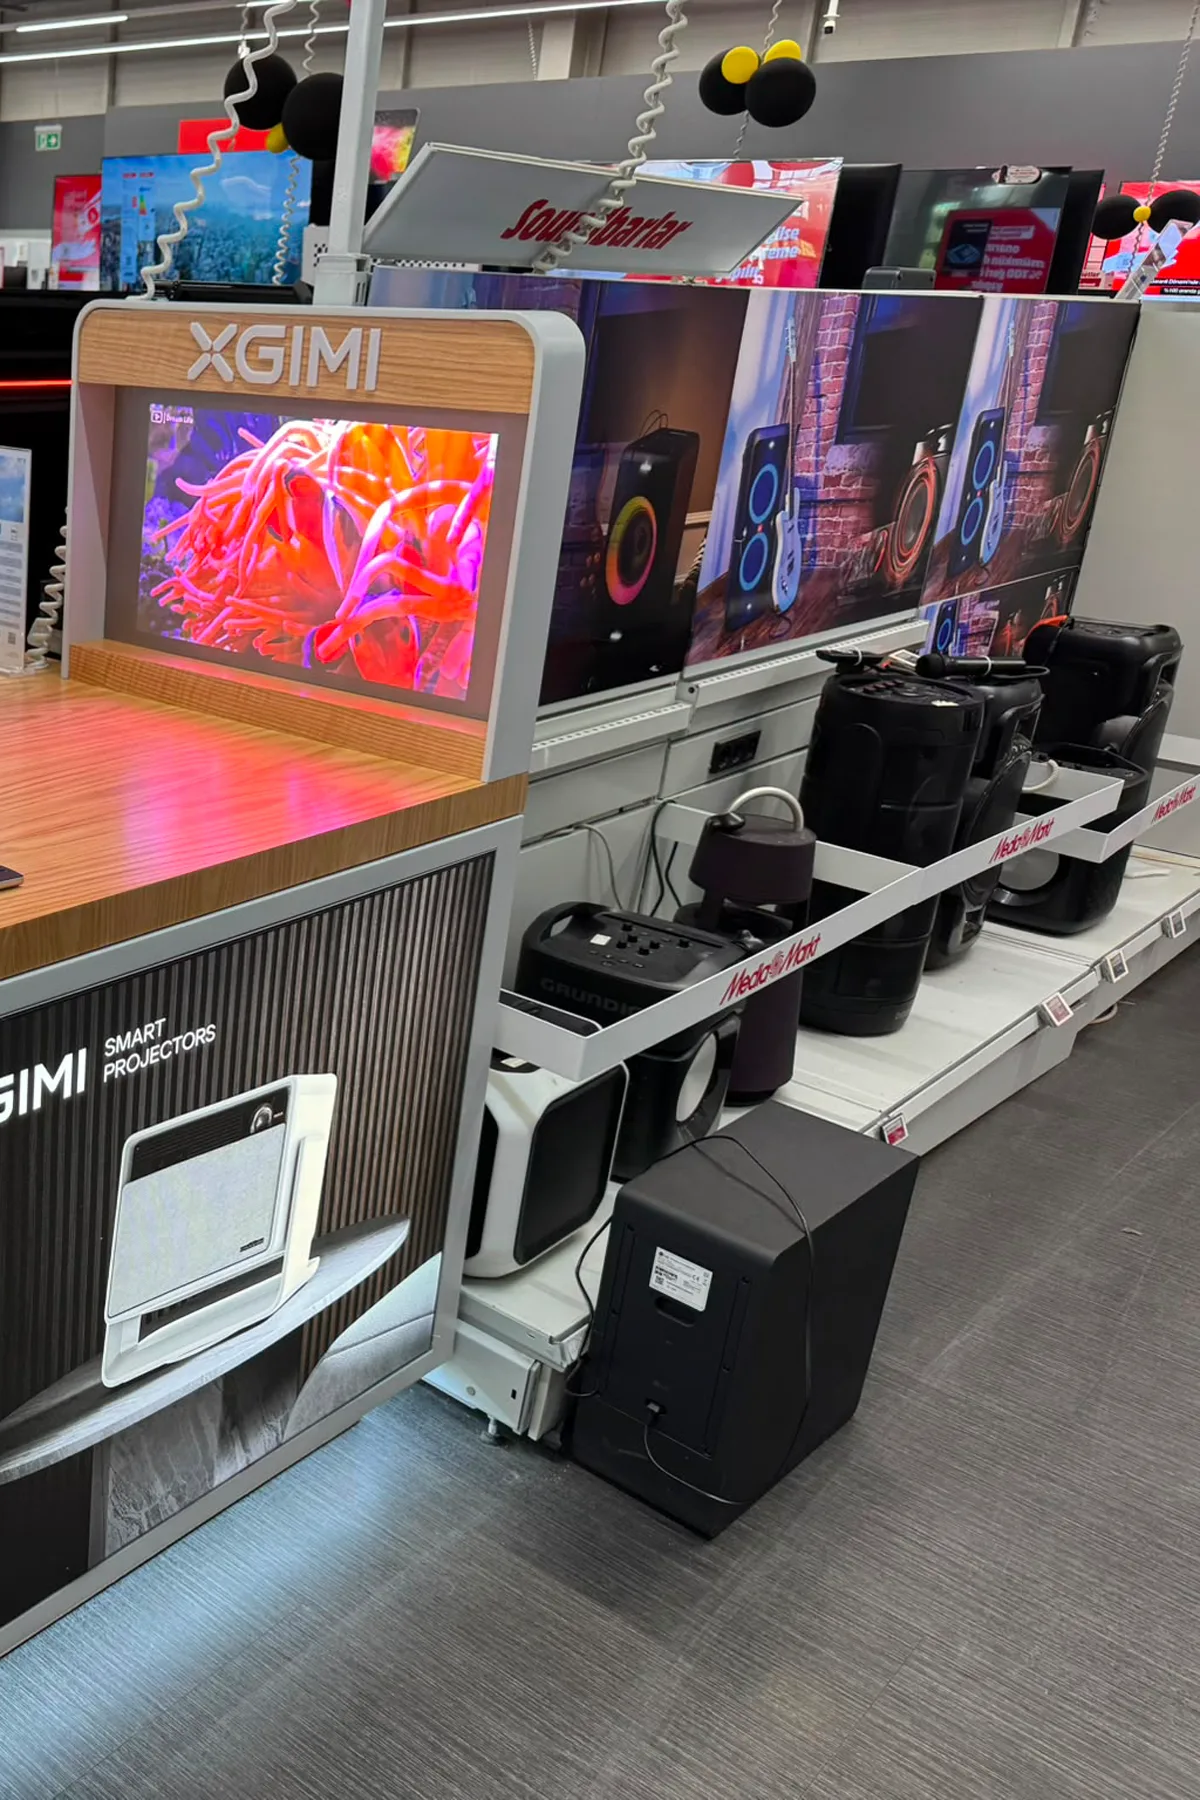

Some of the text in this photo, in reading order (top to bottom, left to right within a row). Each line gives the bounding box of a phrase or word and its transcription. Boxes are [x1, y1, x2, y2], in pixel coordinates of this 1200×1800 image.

[187, 321, 382, 391] XGIMI
[104, 1017, 166, 1058] SMART
[104, 1024, 216, 1083] PROJECTORS
